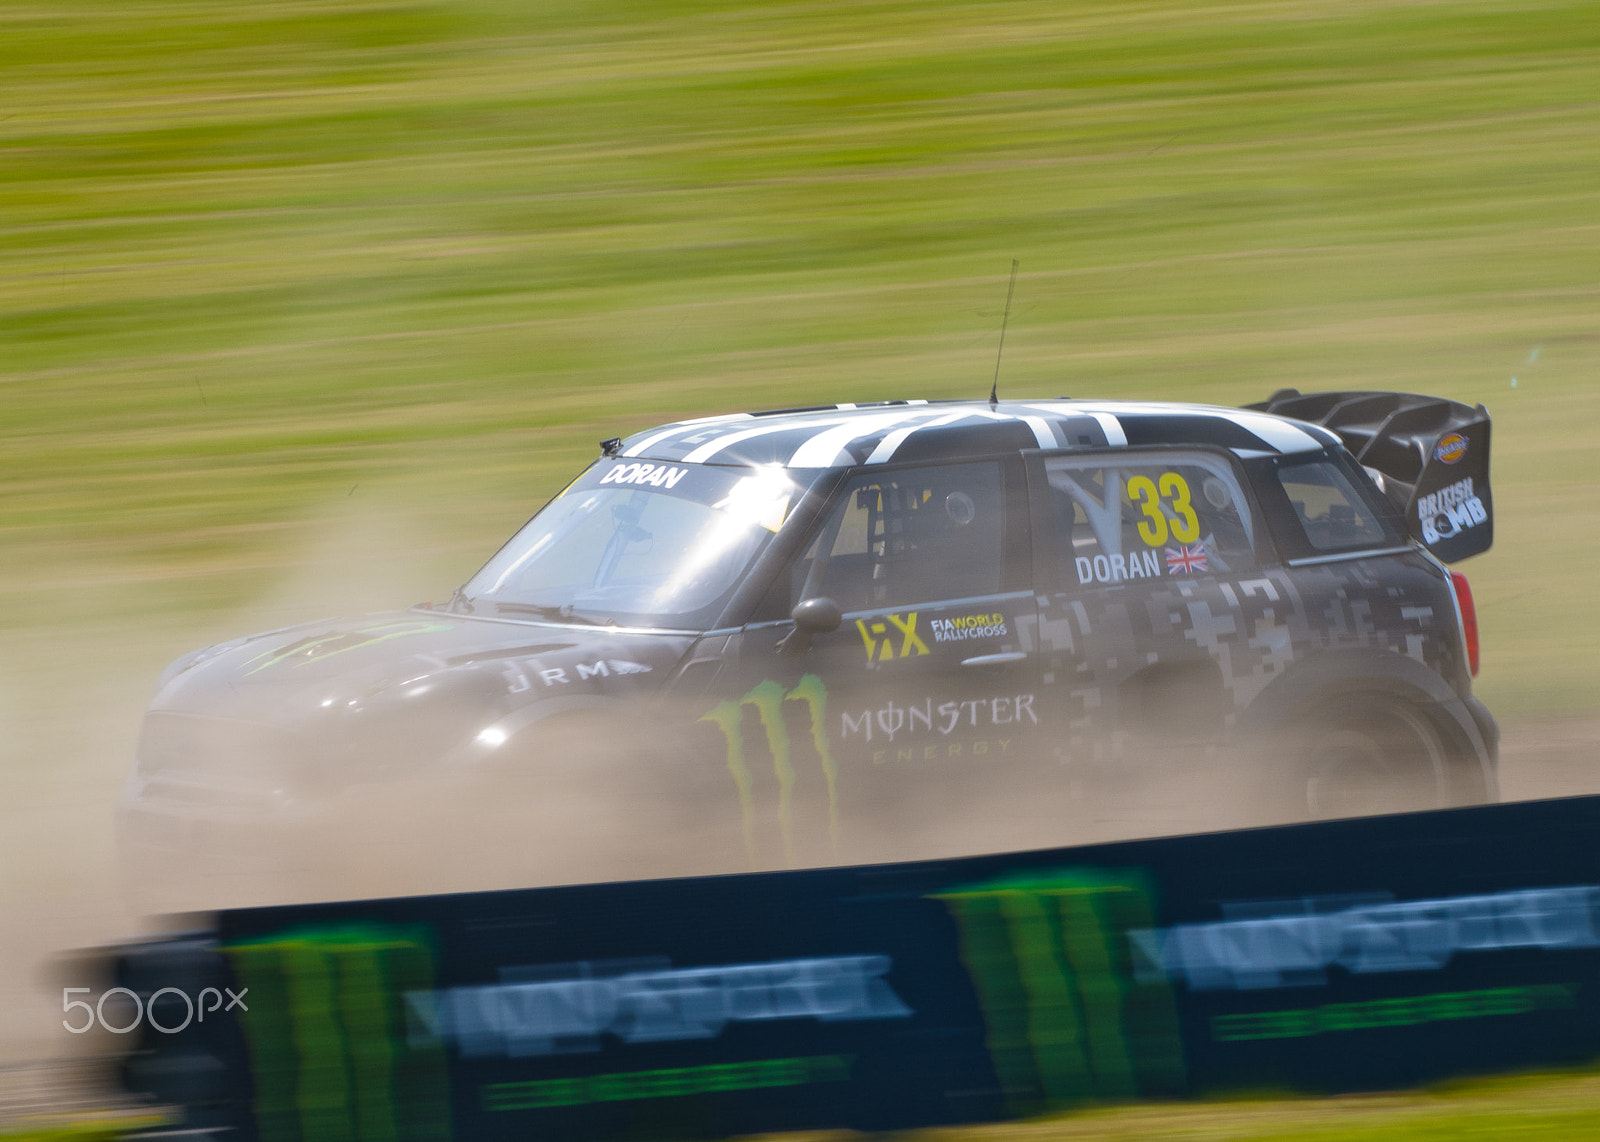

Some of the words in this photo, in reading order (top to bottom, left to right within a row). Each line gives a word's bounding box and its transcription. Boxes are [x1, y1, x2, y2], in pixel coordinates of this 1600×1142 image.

[600, 463, 688, 488] DORAN
[1127, 472, 1200, 547] 33
[1417, 477, 1474, 520] BRITISH
[1421, 496, 1488, 545] BOMB
[1074, 549, 1161, 584] DORAN
[934, 623, 1008, 642] RALLYCROSS
[841, 694, 1038, 742] MONSTER
[873, 739, 1011, 764] ENERGY
